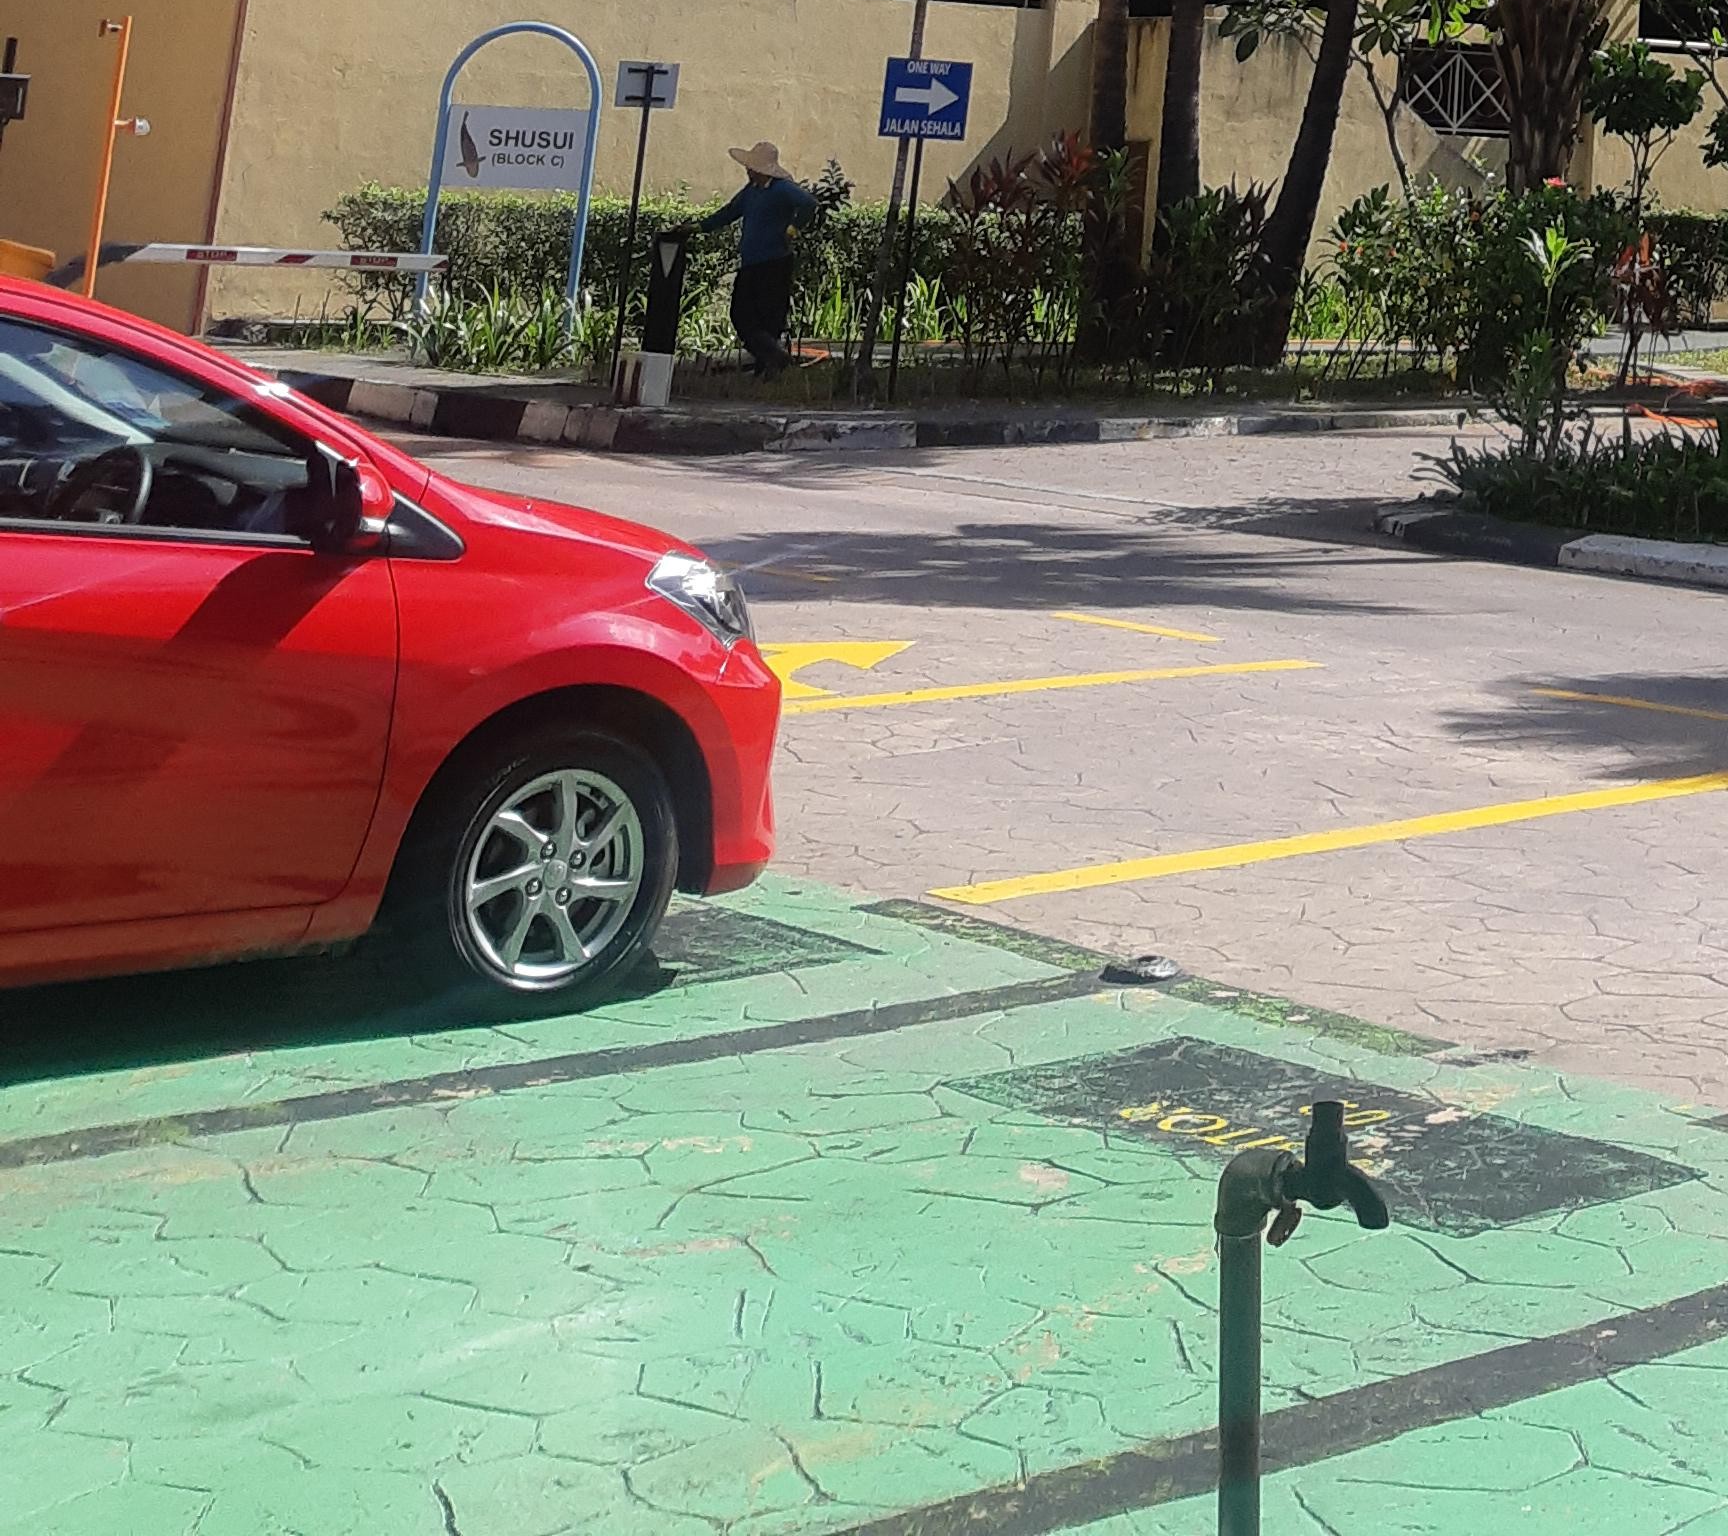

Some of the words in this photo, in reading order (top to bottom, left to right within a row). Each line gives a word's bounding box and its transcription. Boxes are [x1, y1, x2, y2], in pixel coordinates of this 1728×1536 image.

[907, 61, 928, 75] ONE
[930, 62, 952, 76] WAY
[883, 117, 919, 134] JALAN
[920, 120, 962, 136] SEHALA
[488, 128, 575, 150] SHUSUI
[491, 153, 546, 167] (BLOCK
[550, 155, 565, 169] C)
